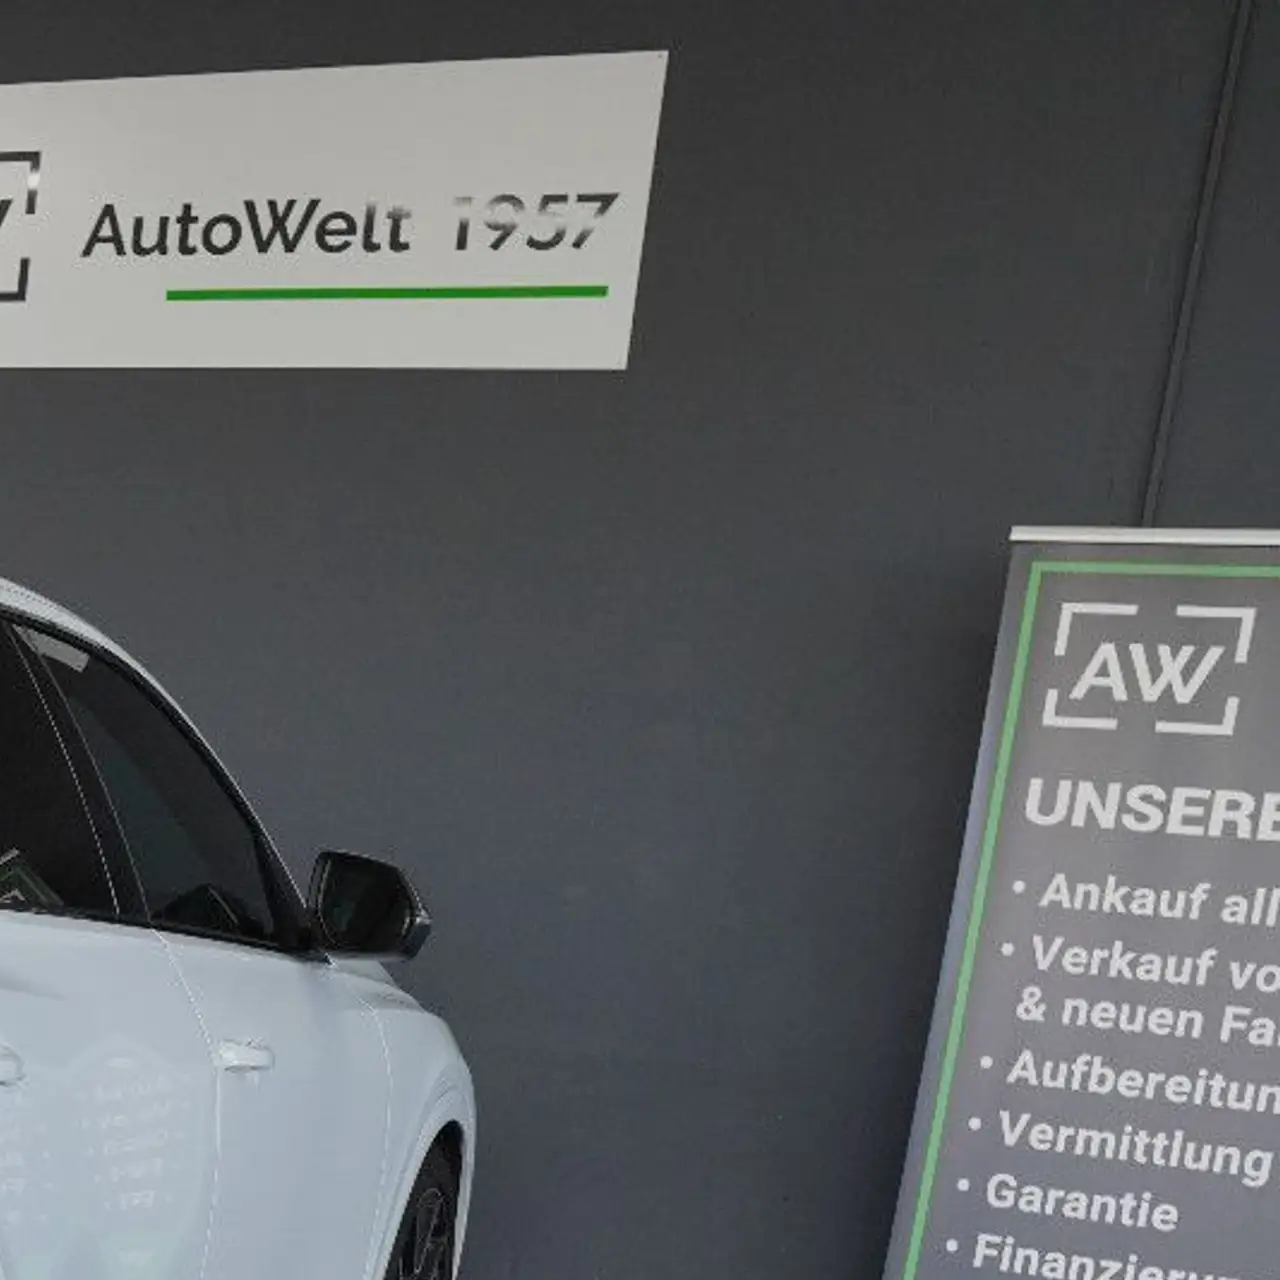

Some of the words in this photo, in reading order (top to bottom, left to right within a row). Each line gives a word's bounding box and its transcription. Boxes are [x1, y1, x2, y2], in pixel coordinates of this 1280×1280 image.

[81, 197, 414, 258] AutoWelt
[452, 191, 620, 252] 1957
[1068, 641, 1225, 705] AW
[1024, 777, 1280, 841] UNSERE
[1040, 872, 1212, 921] Ankauf
[1221, 887, 1280, 928] all
[1032, 935, 1218, 988] Verkauf
[1229, 959, 1280, 994] vo
[1016, 986, 1046, 1022] &
[1061, 996, 1204, 1039] neuen
[1220, 1005, 1280, 1047] Fa
[1006, 1049, 1280, 1115] Aufbereitun
[998, 1110, 1274, 1188] Vermittlung
[986, 1172, 1180, 1233] Garantie
